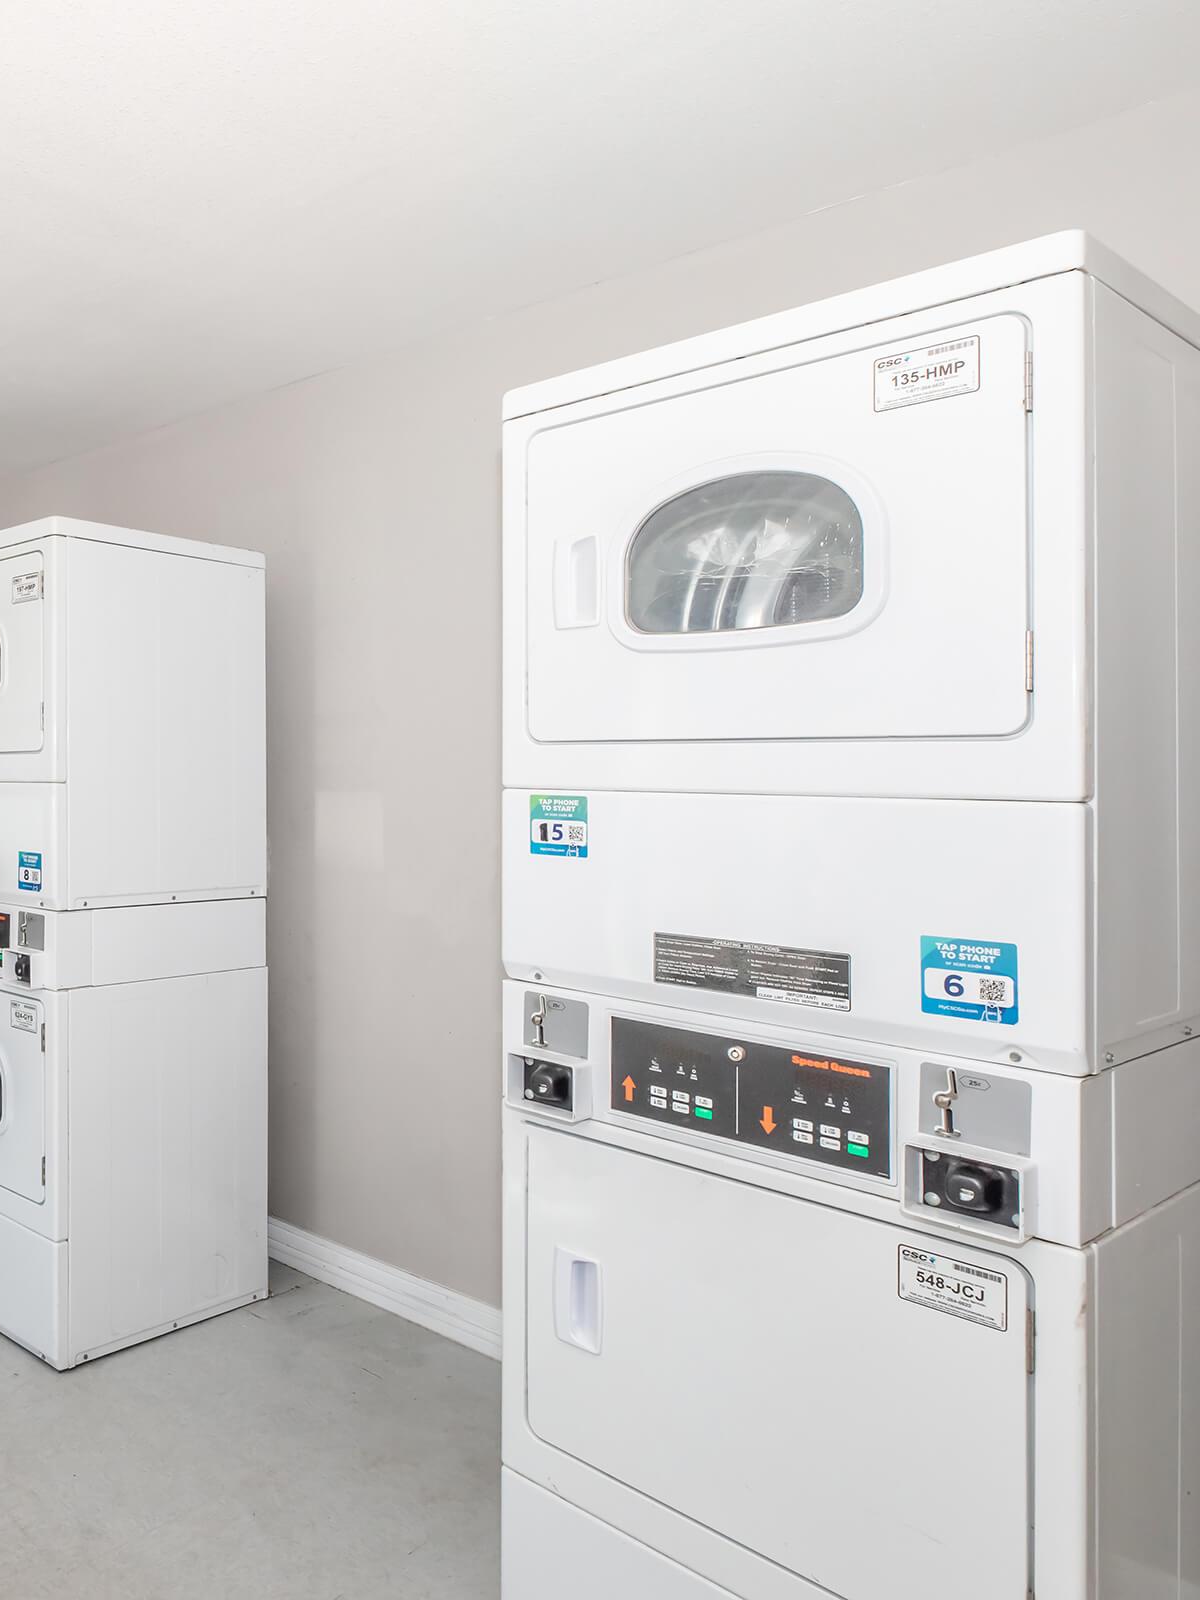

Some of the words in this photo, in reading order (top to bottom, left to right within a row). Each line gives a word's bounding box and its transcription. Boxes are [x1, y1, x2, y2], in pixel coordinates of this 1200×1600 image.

[877, 357, 902, 369] CSC
[891, 360, 966, 387] 135-HMP
[538, 798, 553, 806] TAP
[24, 869, 29, 880] 8
[935, 942, 957, 951] TAP
[959, 945, 1001, 956] PHONE
[940, 950, 956, 959] TO
[958, 953, 996, 964] START
[944, 974, 964, 997] 6
[792, 1055, 829, 1070] Speed
[830, 1062, 872, 1077] Queen
[902, 1249, 928, 1262] CSC
[916, 1271, 985, 1302] 548-JCJ
